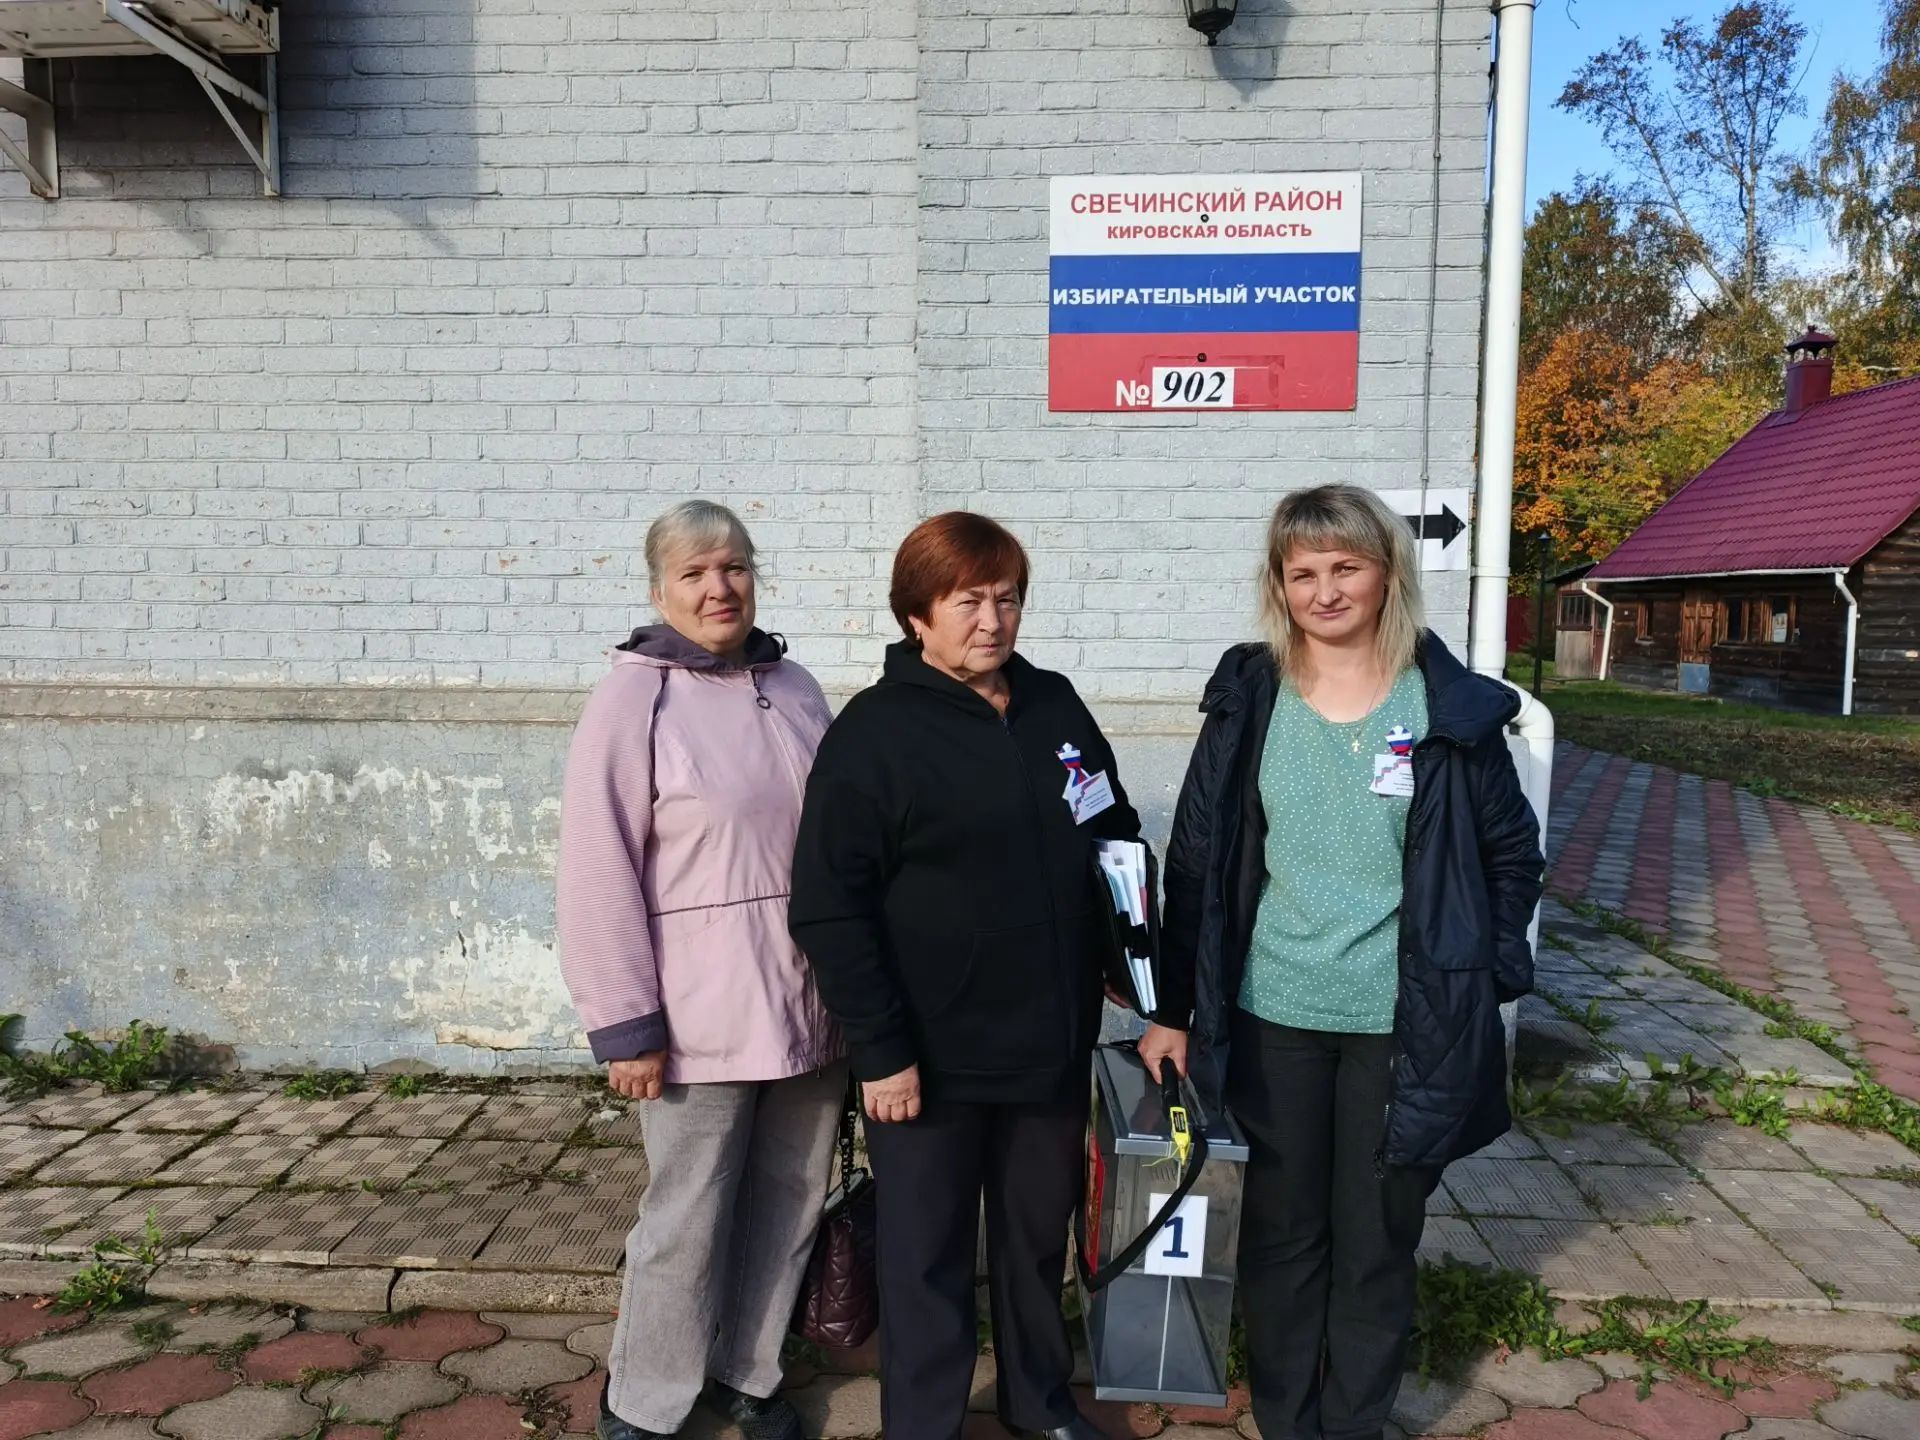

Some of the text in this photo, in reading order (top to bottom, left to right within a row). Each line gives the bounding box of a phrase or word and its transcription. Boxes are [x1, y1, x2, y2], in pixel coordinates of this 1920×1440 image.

[1070, 188, 1343, 213] СВЕЧИНСКИЙ РАЙОН
[1107, 224, 1312, 239] КИРОВСКАЯ ОБЛАСТЬ
[1053, 284, 1356, 305] ИЗБИРАТЕЛЬНЫЙ УЧАСТОК
[1161, 371, 1226, 403] 902
[1162, 1216, 1189, 1259] 1
